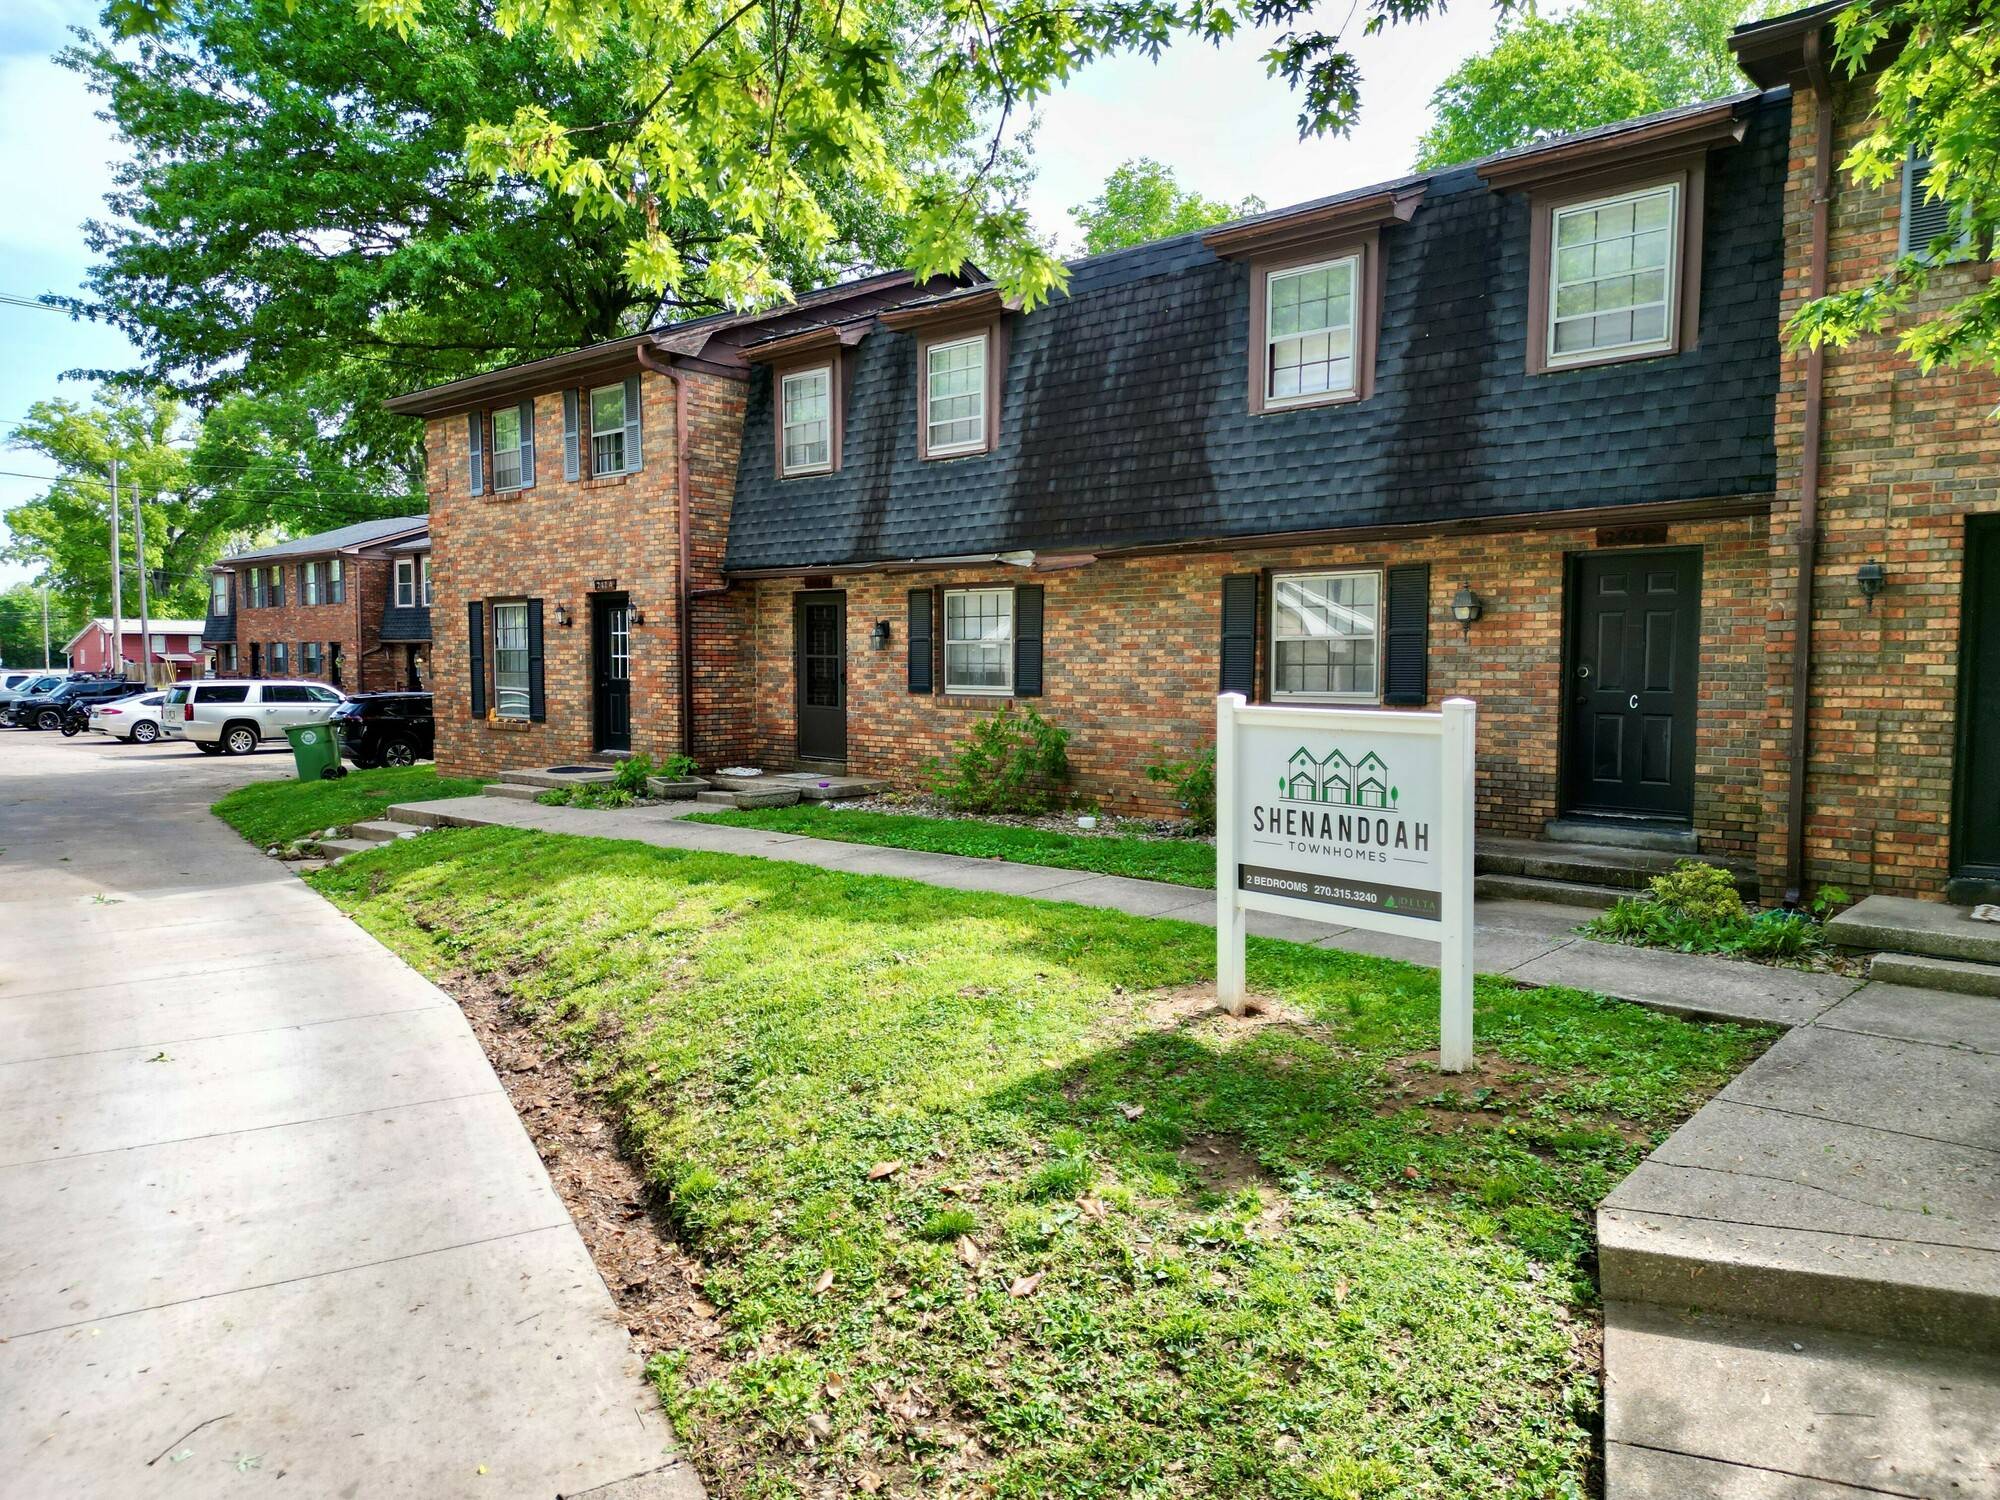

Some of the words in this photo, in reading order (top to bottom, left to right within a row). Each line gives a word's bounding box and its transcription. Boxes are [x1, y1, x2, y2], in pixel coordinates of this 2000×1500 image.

[1629, 694, 1638, 709] C
[1253, 805, 1429, 851] SHENANDOAH
[1288, 841, 1387, 863] TOWNHOMES
[1246, 875, 1253, 884] 2
[1254, 875, 1308, 893] BEDROOMS
[1314, 885, 1377, 904] 270.315.3240
